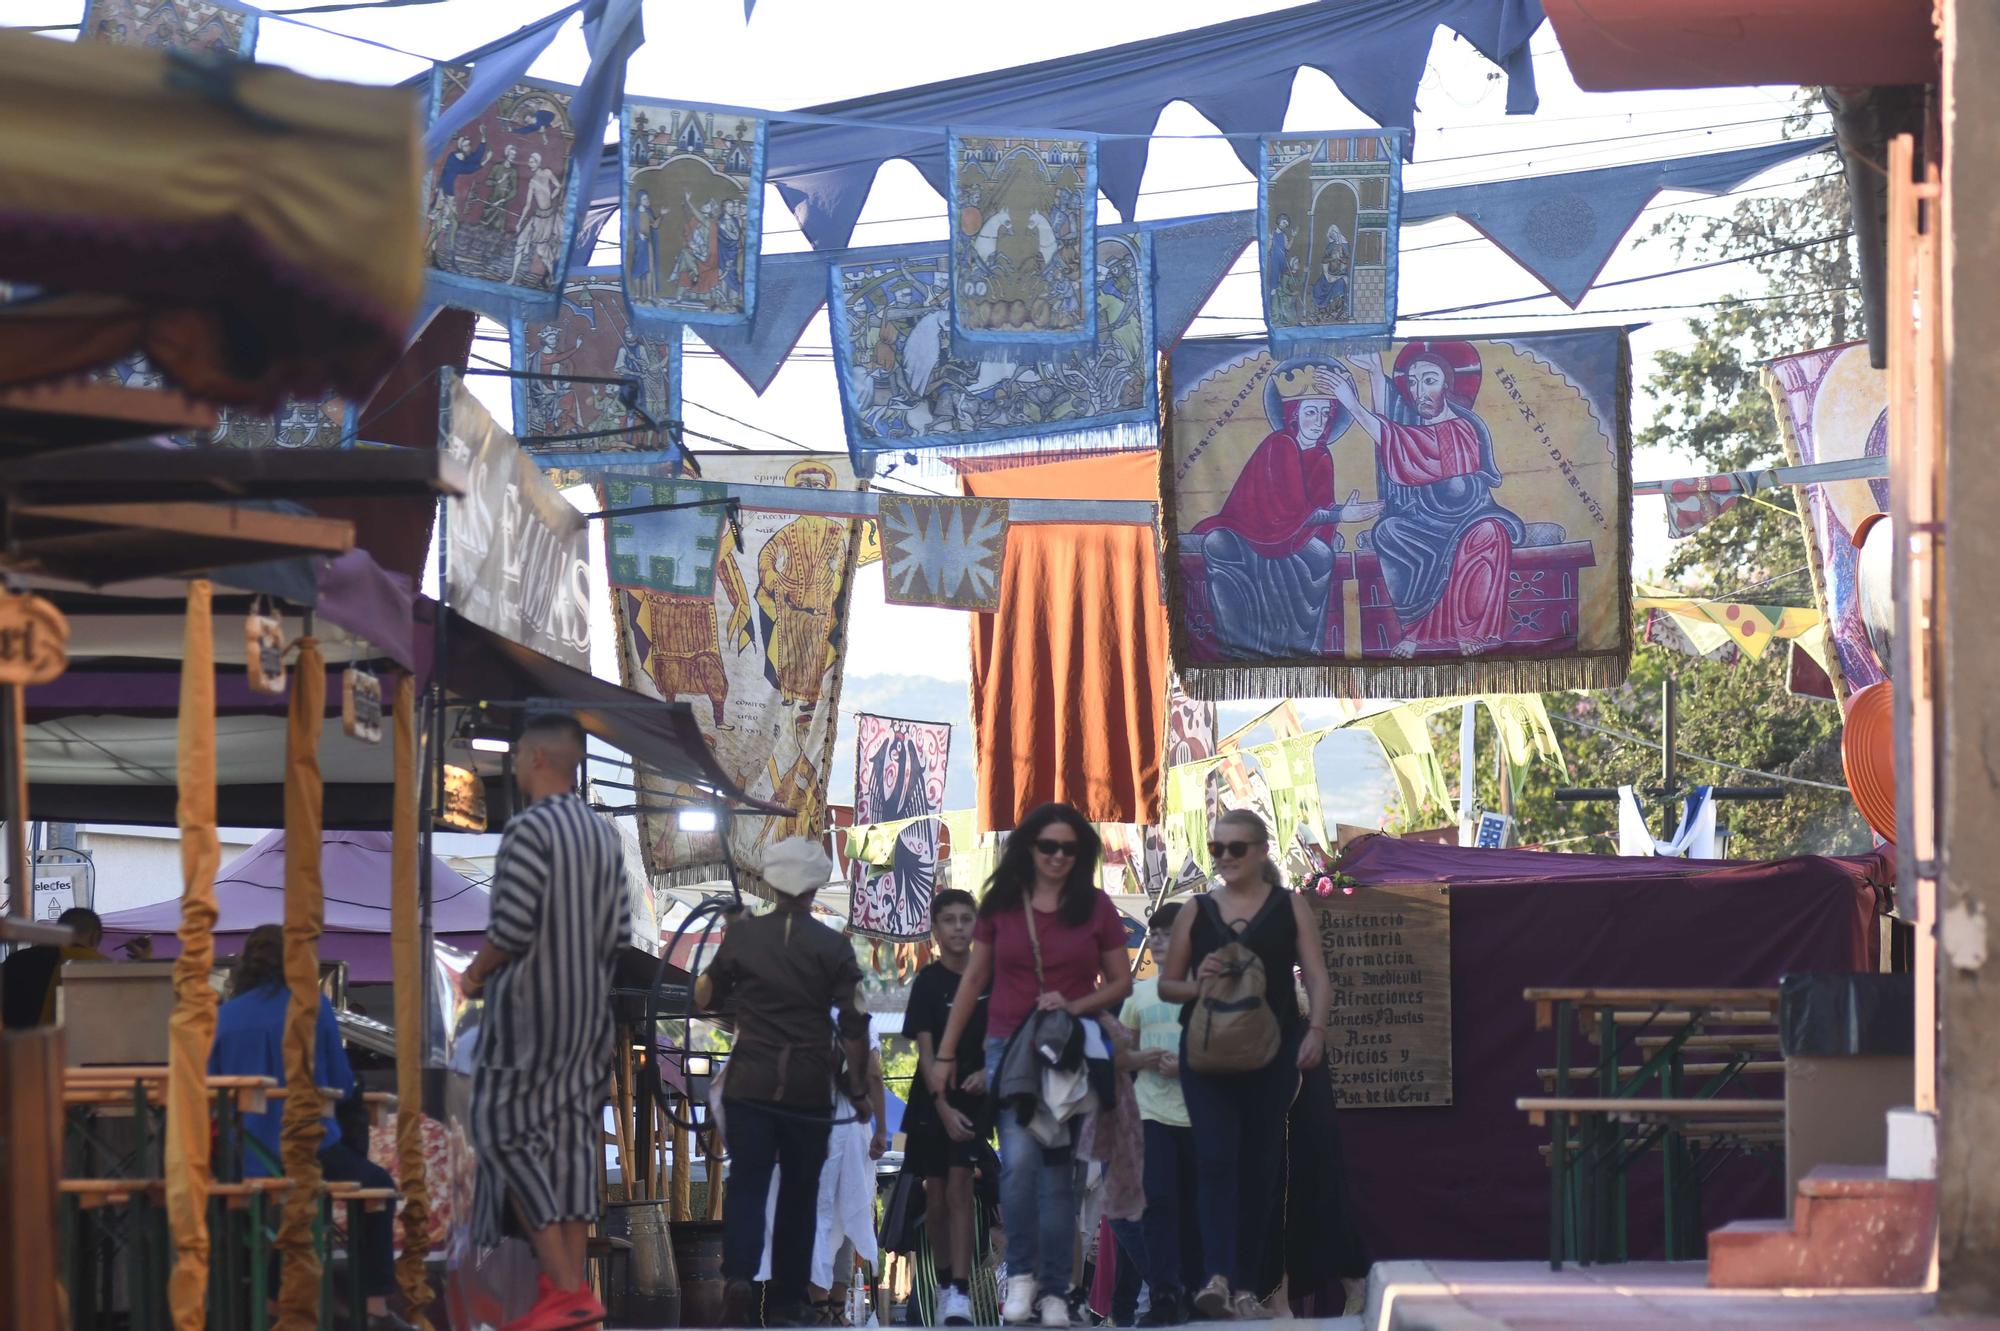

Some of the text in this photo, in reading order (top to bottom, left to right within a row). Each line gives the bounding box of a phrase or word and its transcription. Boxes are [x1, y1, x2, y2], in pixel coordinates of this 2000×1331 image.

[1320, 910, 1403, 930] Asistencia
[1322, 930, 1402, 948] Sanitaria
[1332, 989, 1423, 1006] Atracciones
[1384, 1008, 1423, 1024] Justas
[1345, 1029, 1392, 1048] Aseos
[1328, 1047, 1409, 1065] Oficios y
[1329, 1067, 1424, 1084] Exposiciones
[1366, 1088, 1381, 1103] de
[1384, 1088, 1397, 1102] la
